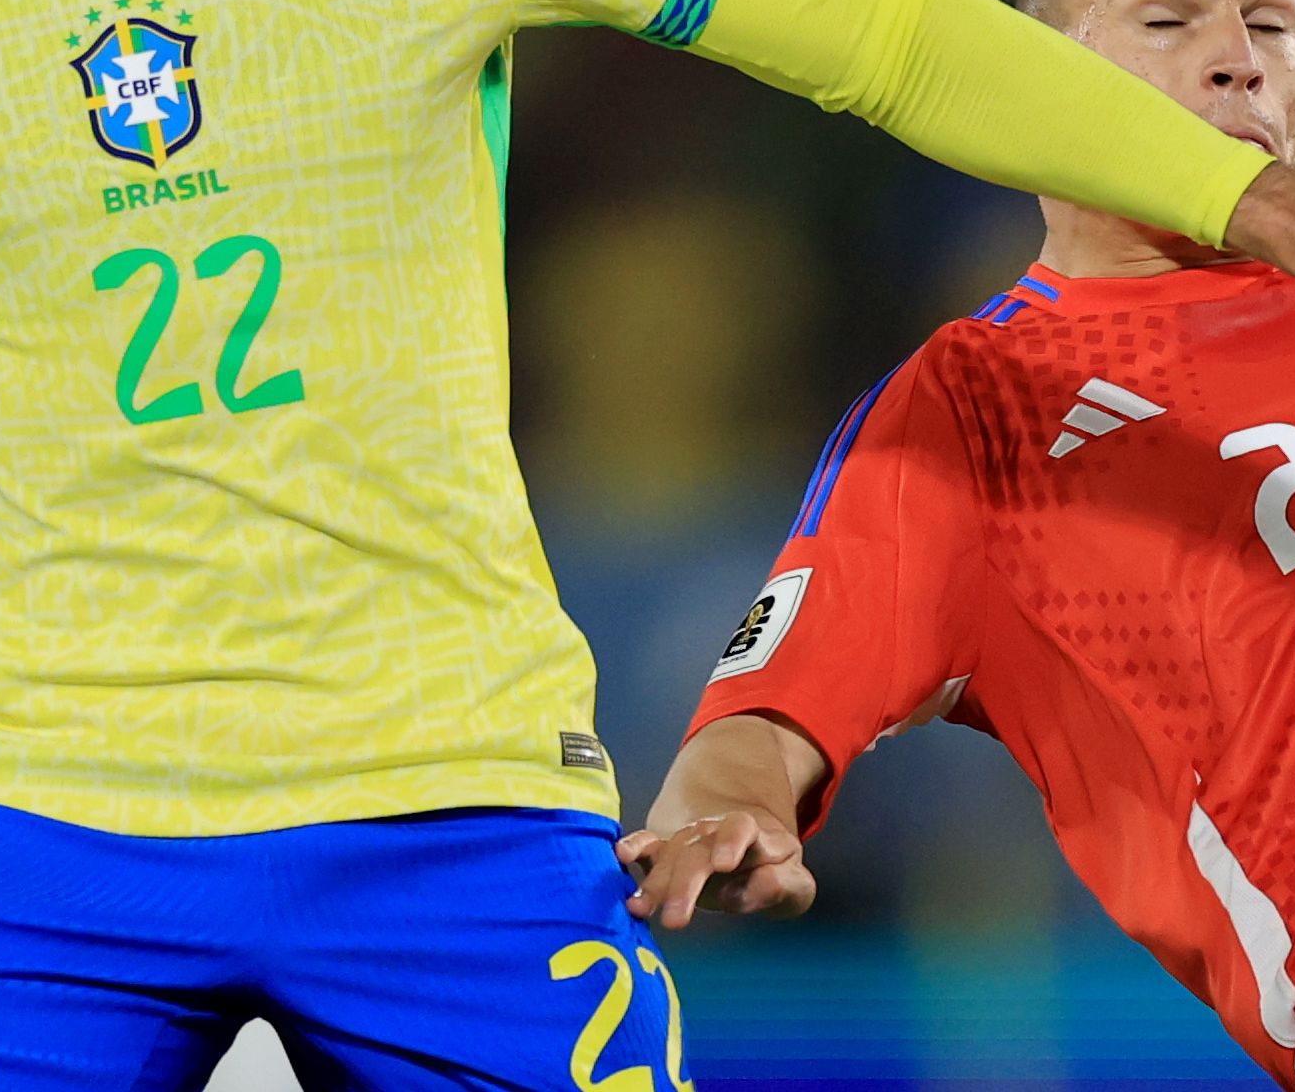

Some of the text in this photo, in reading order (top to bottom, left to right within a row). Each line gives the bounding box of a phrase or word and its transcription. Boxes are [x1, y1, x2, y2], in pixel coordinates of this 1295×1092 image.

[117, 77, 162, 100] CBF
[102, 168, 230, 215] BRASIL
[92, 235, 306, 426] 22
[548, 940, 696, 1092] 22
